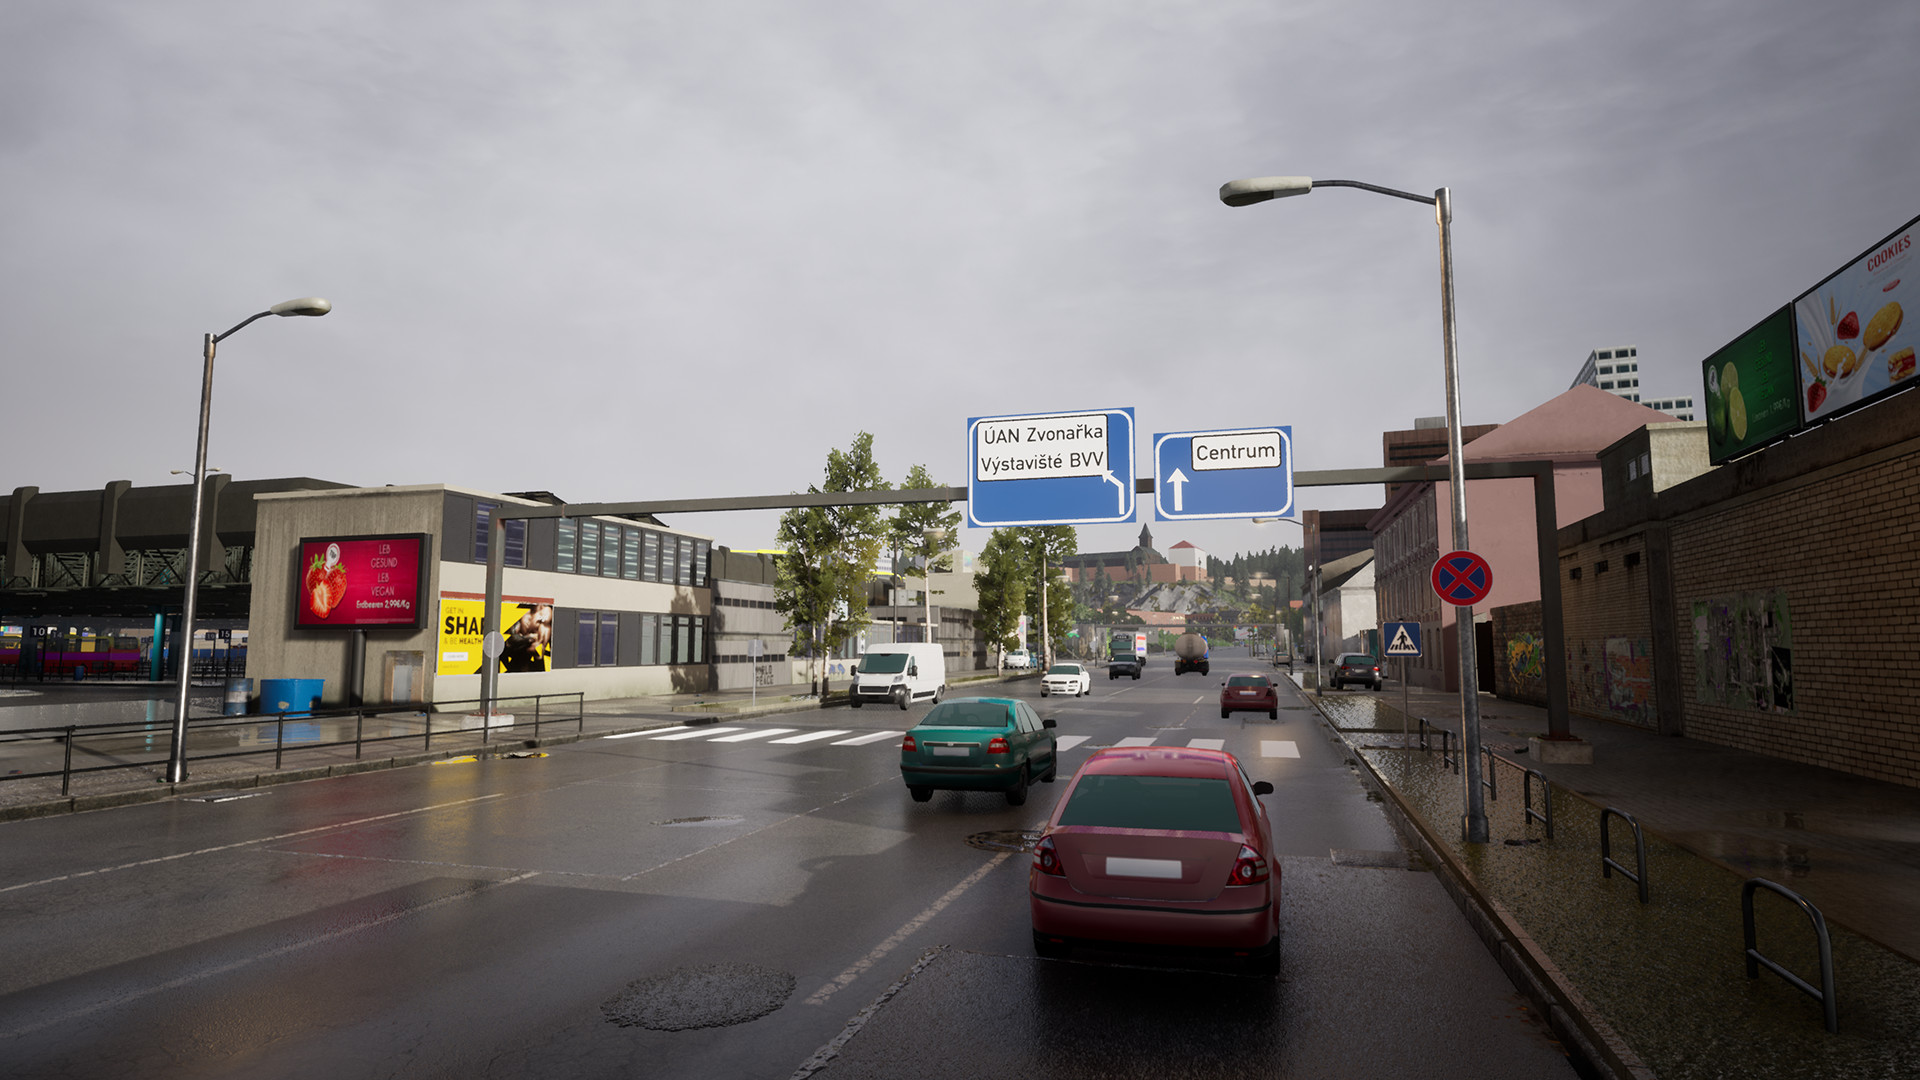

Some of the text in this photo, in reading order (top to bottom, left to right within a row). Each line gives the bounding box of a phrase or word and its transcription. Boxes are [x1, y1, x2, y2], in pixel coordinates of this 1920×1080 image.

[1868, 234, 1911, 272] COOKIES
[984, 424, 1103, 445] ÚAN Zvonařka
[1196, 444, 1276, 461] Centrum
[981, 451, 1104, 475] Výstaviště BVV
[379, 544, 390, 555] LEB
[371, 557, 397, 568] GESUND
[378, 572, 389, 583] LEB
[371, 586, 395, 597] VEGAN
[446, 606, 457, 614] GET
[32, 627, 45, 636] 10
[221, 630, 230, 638] 15
